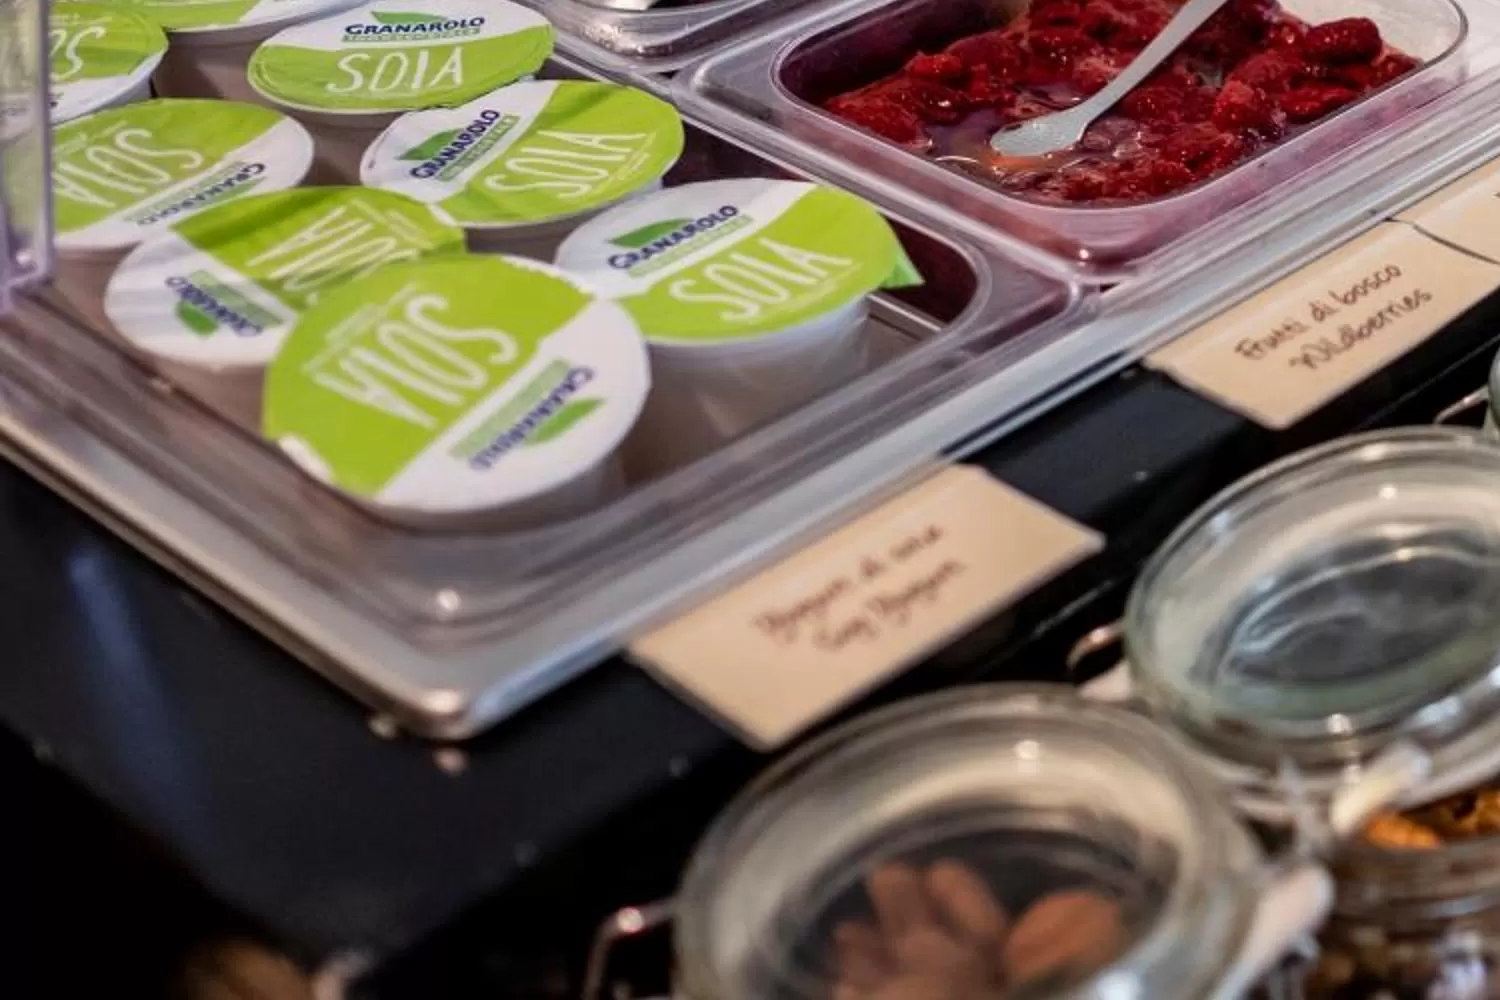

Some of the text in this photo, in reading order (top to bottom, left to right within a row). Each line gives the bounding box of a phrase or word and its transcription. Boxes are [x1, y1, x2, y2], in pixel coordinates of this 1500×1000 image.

[345, 17, 485, 35] GRANAROLO
[325, 47, 463, 93] SOIA
[410, 109, 500, 179] GRANAROLO
[484, 130, 647, 198] SOIA
[608, 205, 738, 269] GRANAROLO
[670, 237, 852, 322] SOIA
[1235, 264, 1403, 360] Frutti di bosco
[314, 294, 518, 429] SOIA
